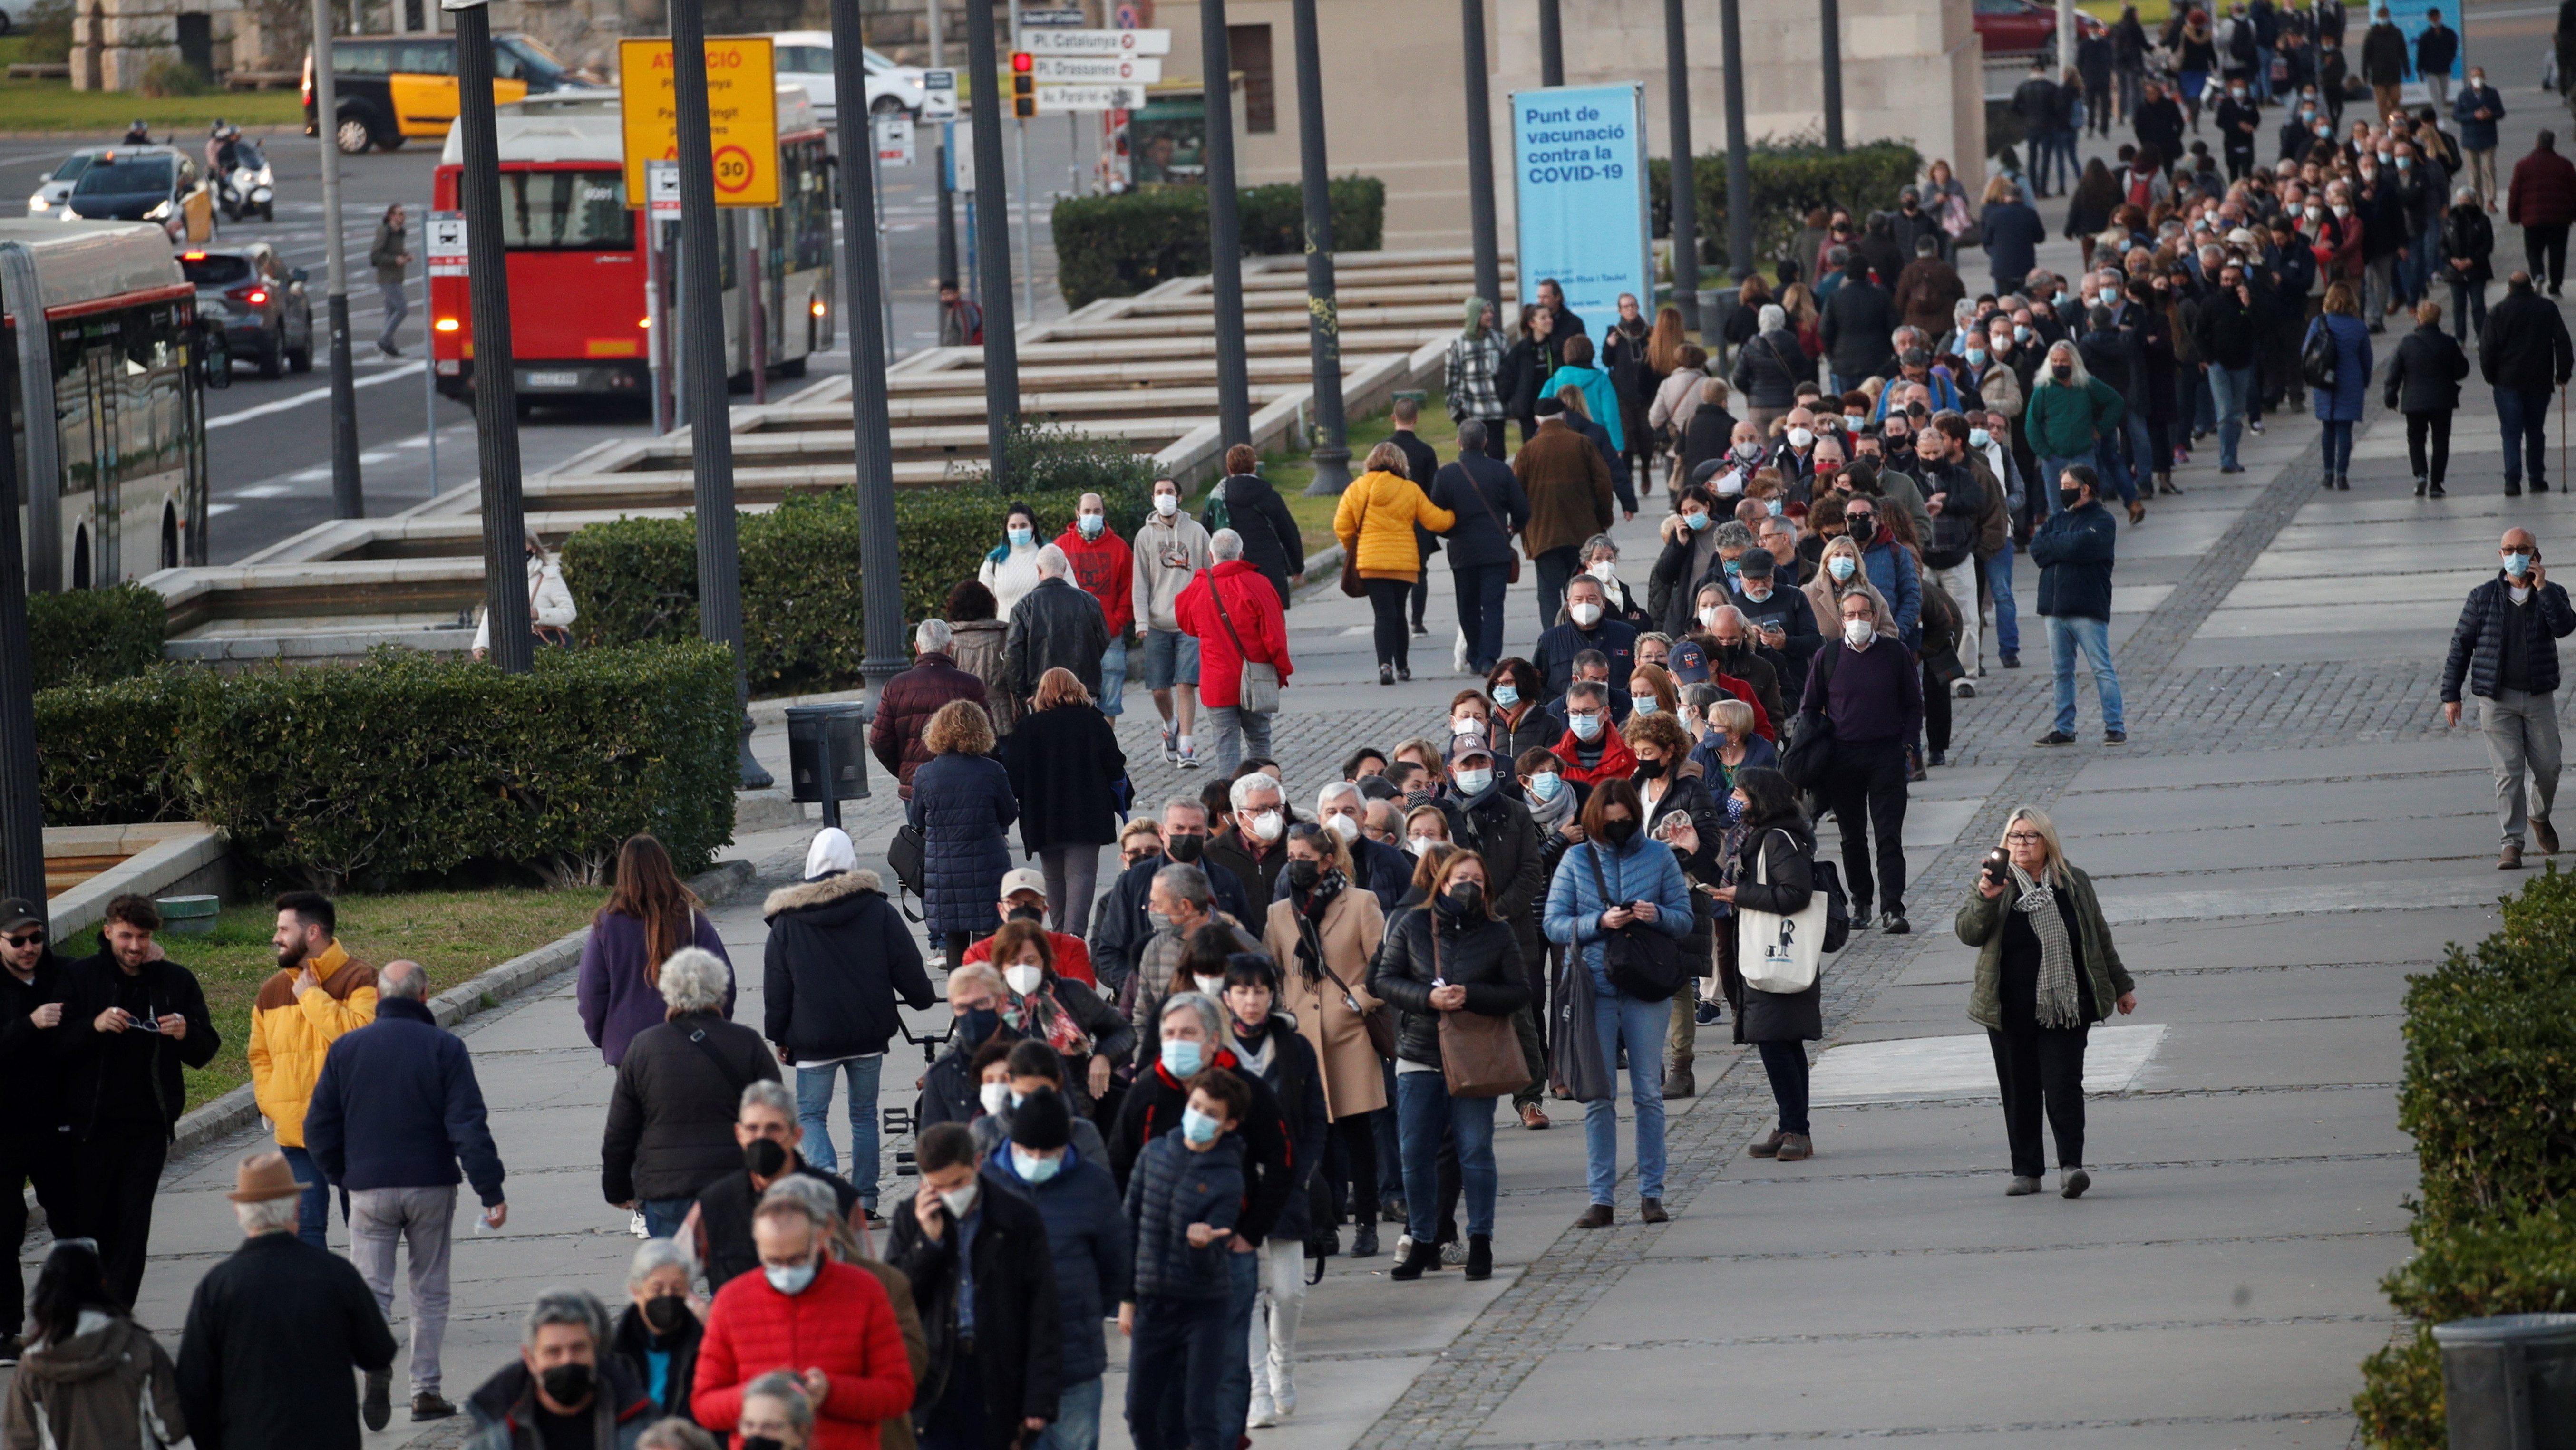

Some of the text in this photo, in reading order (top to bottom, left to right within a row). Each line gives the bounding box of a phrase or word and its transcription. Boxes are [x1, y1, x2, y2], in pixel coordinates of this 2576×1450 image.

[1054, 33, 1118, 49] Catalunya
[651, 47, 743, 69] ATCIÓ
[1055, 61, 1116, 76] Drassanes
[1526, 106, 1599, 124] Punt de
[1528, 124, 1625, 144] vacunació
[1528, 145, 1612, 164] contra la
[719, 162, 744, 176] 30
[1529, 163, 1623, 184] COVID-19
[1464, 737, 1477, 747] NY
